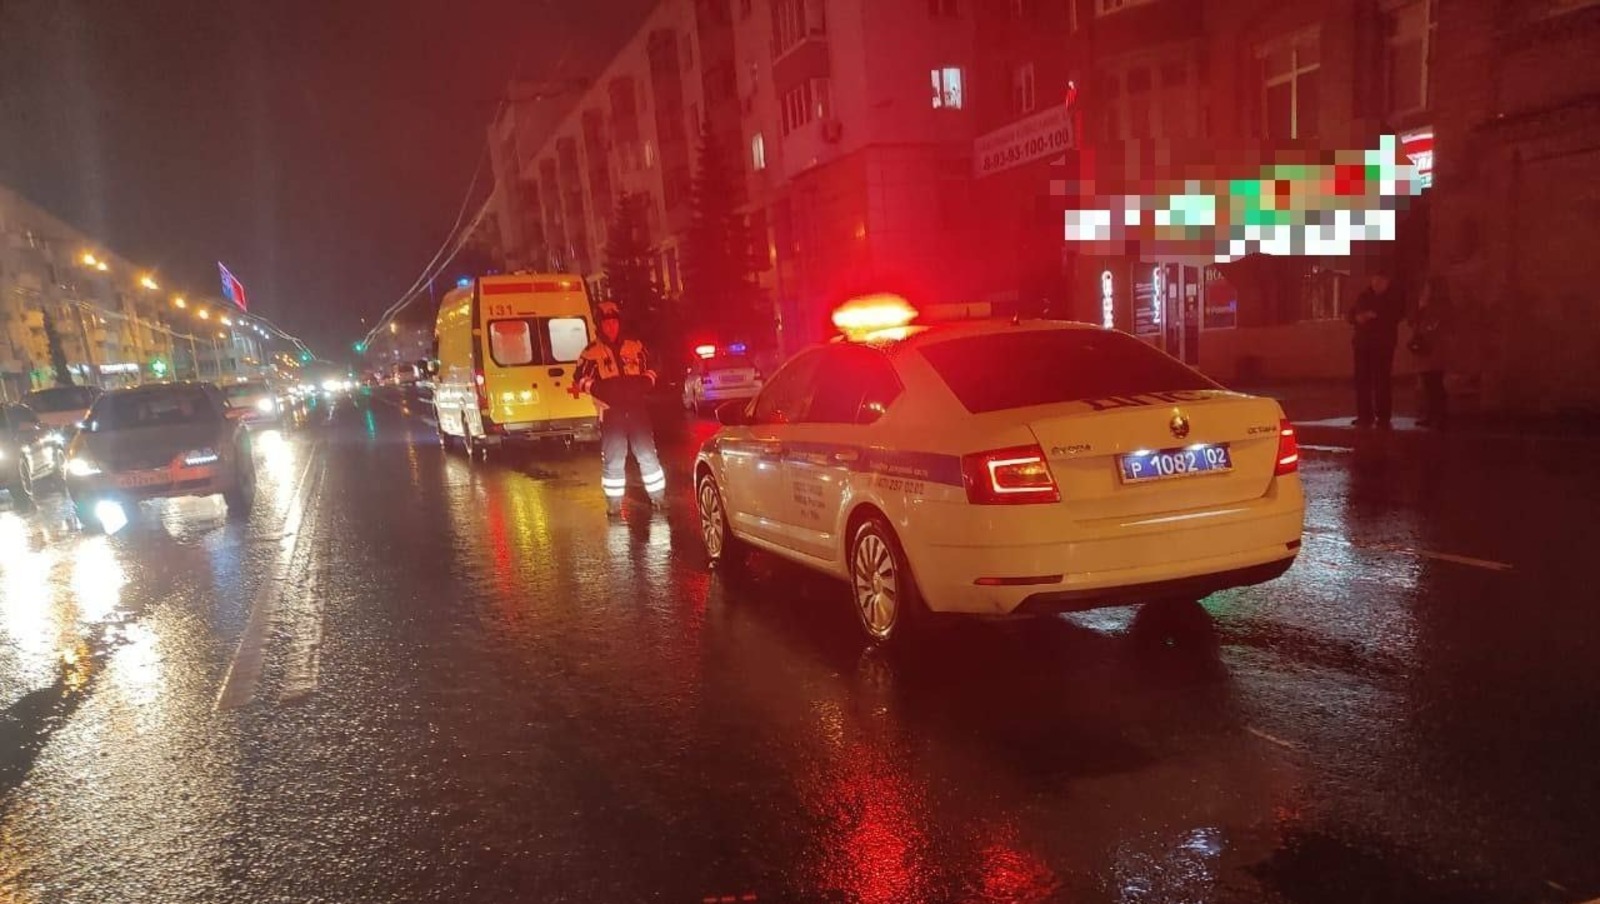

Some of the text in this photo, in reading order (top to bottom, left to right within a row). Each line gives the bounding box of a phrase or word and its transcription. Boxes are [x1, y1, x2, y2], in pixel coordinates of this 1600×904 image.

[488, 304, 513, 316] 131
[1130, 462, 1142, 478] Р
[1150, 451, 1199, 475] 1082
[1206, 447, 1227, 464] 02
